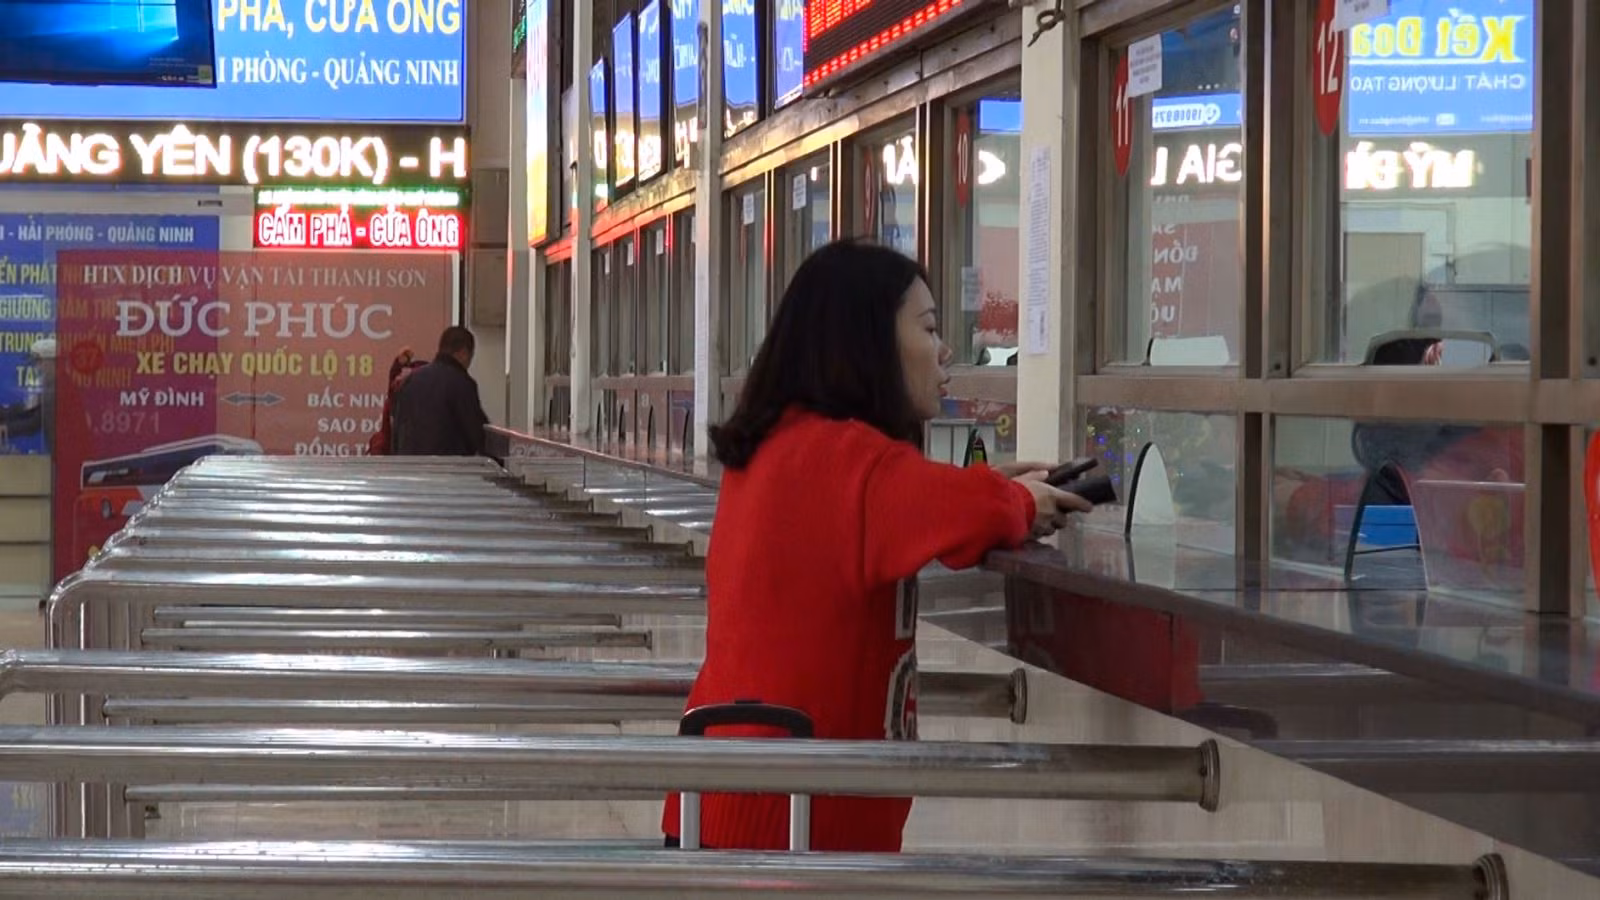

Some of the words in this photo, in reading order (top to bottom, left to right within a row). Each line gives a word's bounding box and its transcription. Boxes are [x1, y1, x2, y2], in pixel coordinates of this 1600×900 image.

[232, 50, 306, 83] PHÒNG
[324, 51, 401, 89] QUẢNG
[405, 59, 459, 86] NINH
[130, 125, 231, 176] YÊN
[243, 135, 388, 185] (130K)
[429, 137, 467, 178] H
[159, 226, 194, 243] NINH
[415, 208, 460, 247] ÔNG
[84, 265, 126, 285] HTX
[132, 264, 183, 288] DỊCH
[189, 265, 216, 289] VỤ
[312, 266, 381, 287] THANH
[386, 266, 427, 288] SƠN
[115, 294, 230, 338] ĐỨC
[244, 296, 393, 340] PHÚC
[136, 352, 165, 374] XE
[173, 352, 234, 379] CHẠY
[241, 345, 303, 376] QUỐC
[310, 350, 338, 380] LỘ
[346, 355, 373, 376] 18
[119, 387, 148, 406] MỸ
[154, 386, 204, 407] ĐÌNH
[349, 392, 389, 407] NIN
[318, 417, 357, 433] SAO
